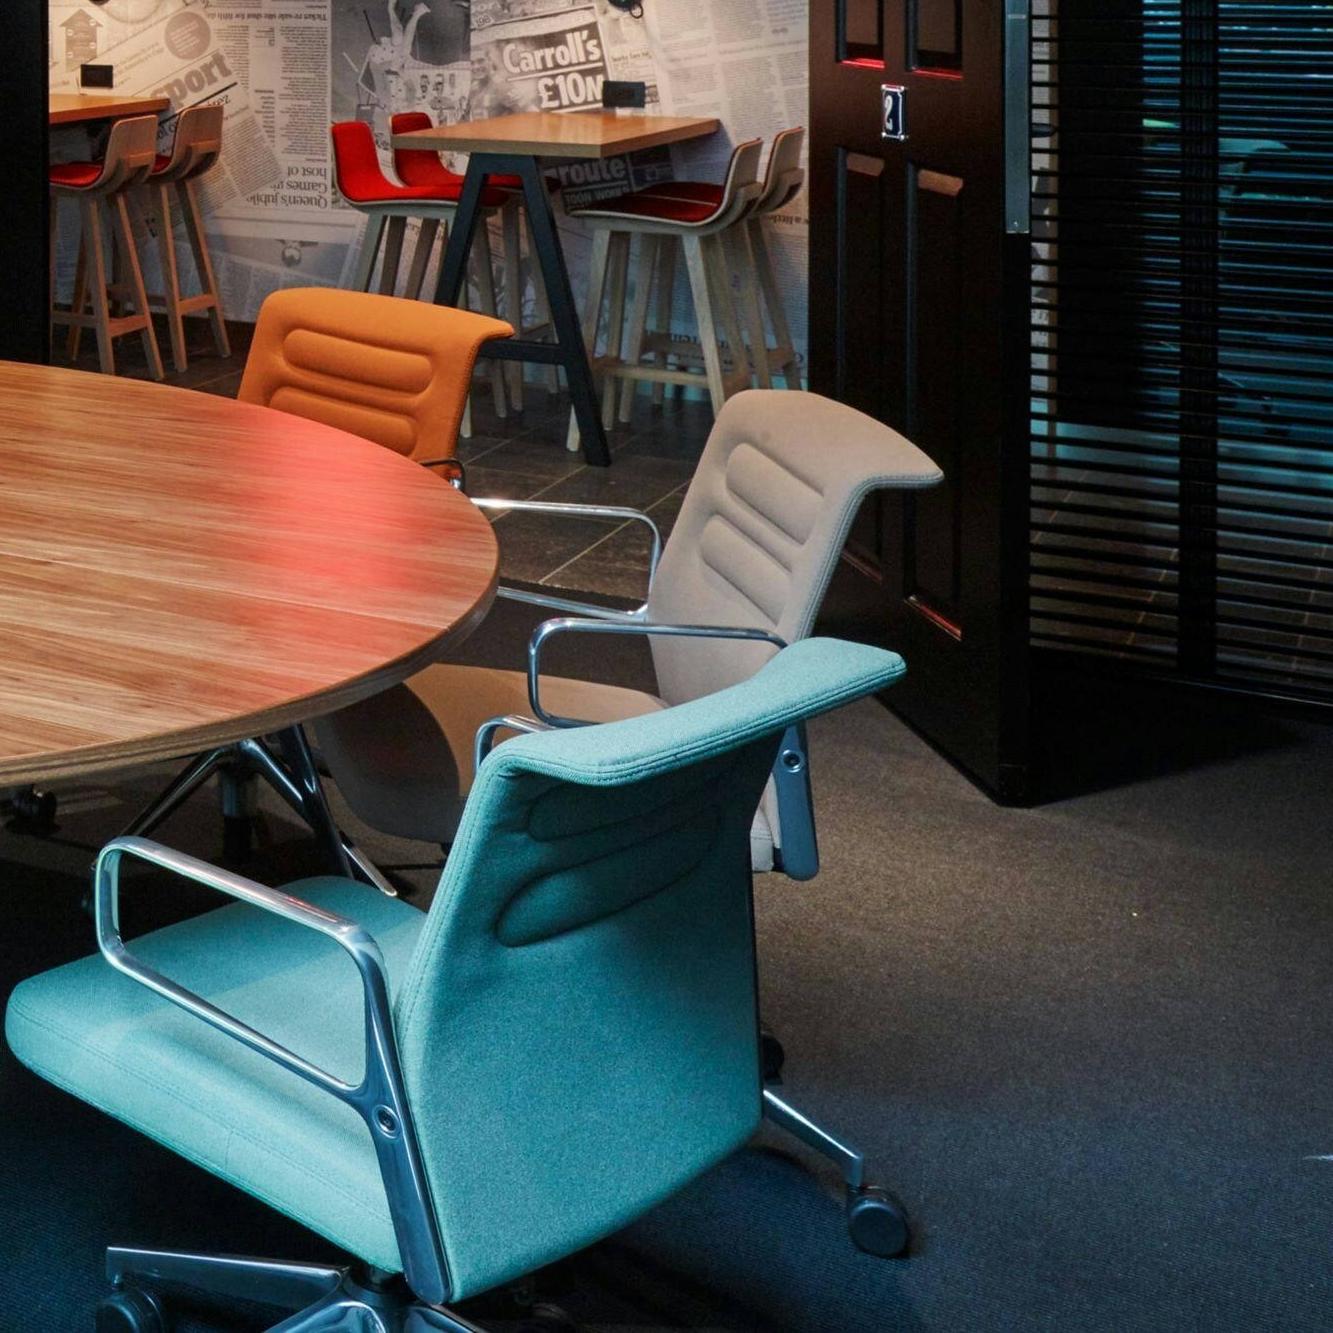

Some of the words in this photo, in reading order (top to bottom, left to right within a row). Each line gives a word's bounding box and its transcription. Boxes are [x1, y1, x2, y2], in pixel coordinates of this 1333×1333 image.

[302, 12, 327, 21] Ticket
[502, 30, 601, 74] Carroll's
[298, 167, 328, 179] host
[561, 157, 627, 185] route
[286, 181, 328, 192] Games
[280, 195, 328, 209] Queen's
